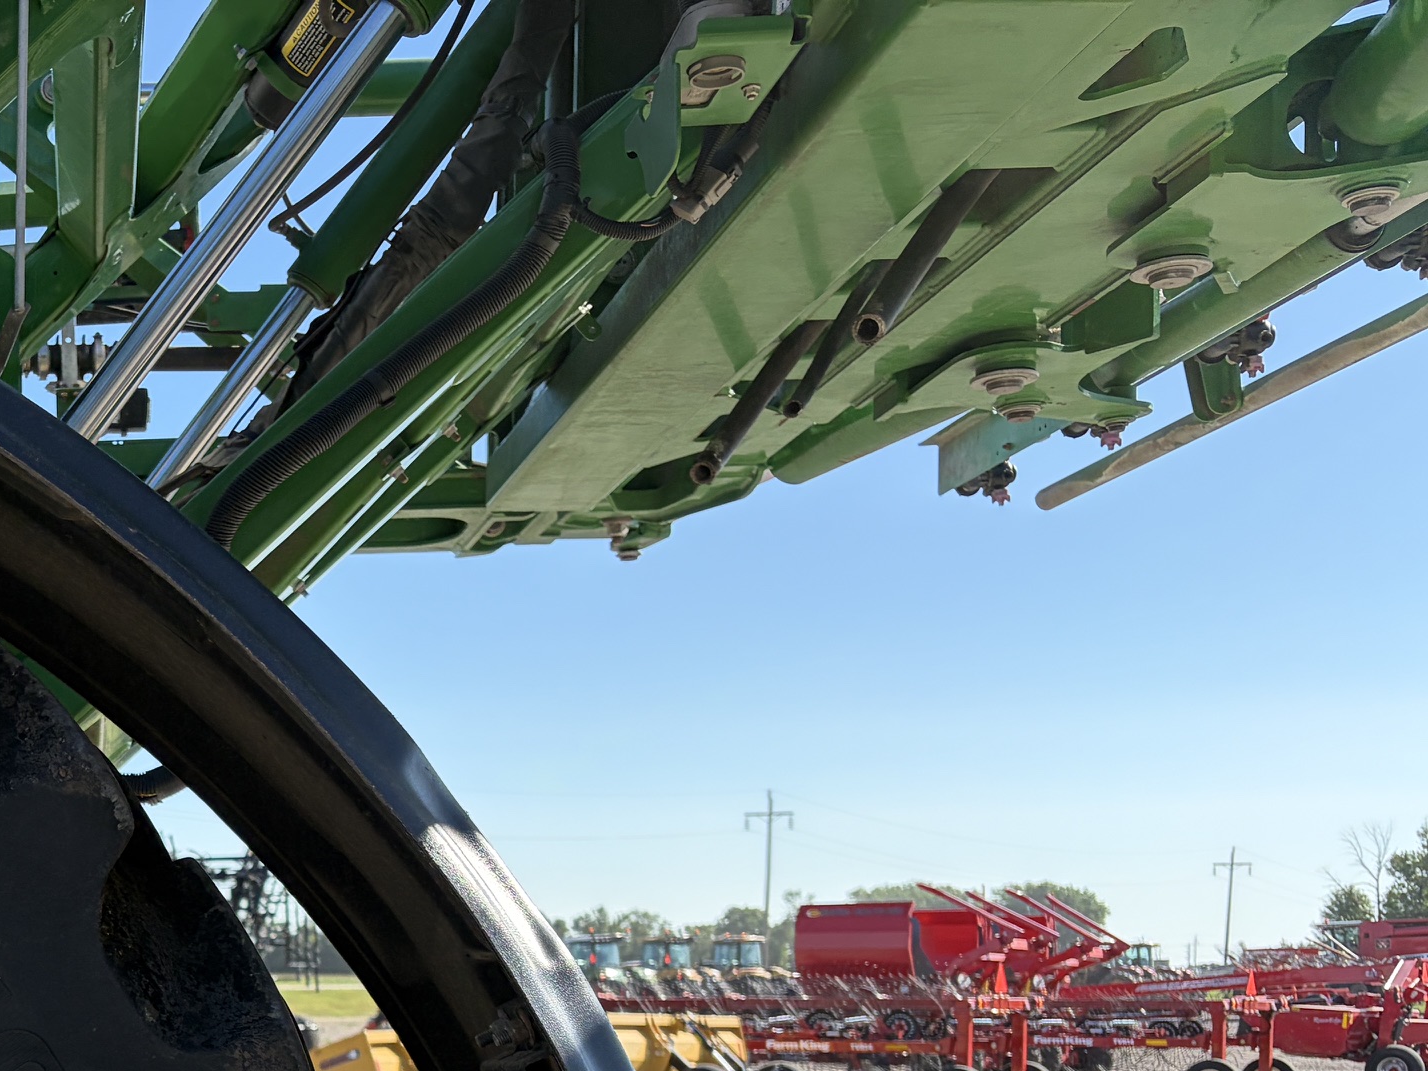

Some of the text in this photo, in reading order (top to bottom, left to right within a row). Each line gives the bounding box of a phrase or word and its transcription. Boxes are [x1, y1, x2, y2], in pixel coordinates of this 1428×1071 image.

[765, 1038, 798, 1051] Farm
[798, 1038, 831, 1053] King
[1033, 1035, 1064, 1046] Farm
[1065, 1035, 1094, 1047] King
